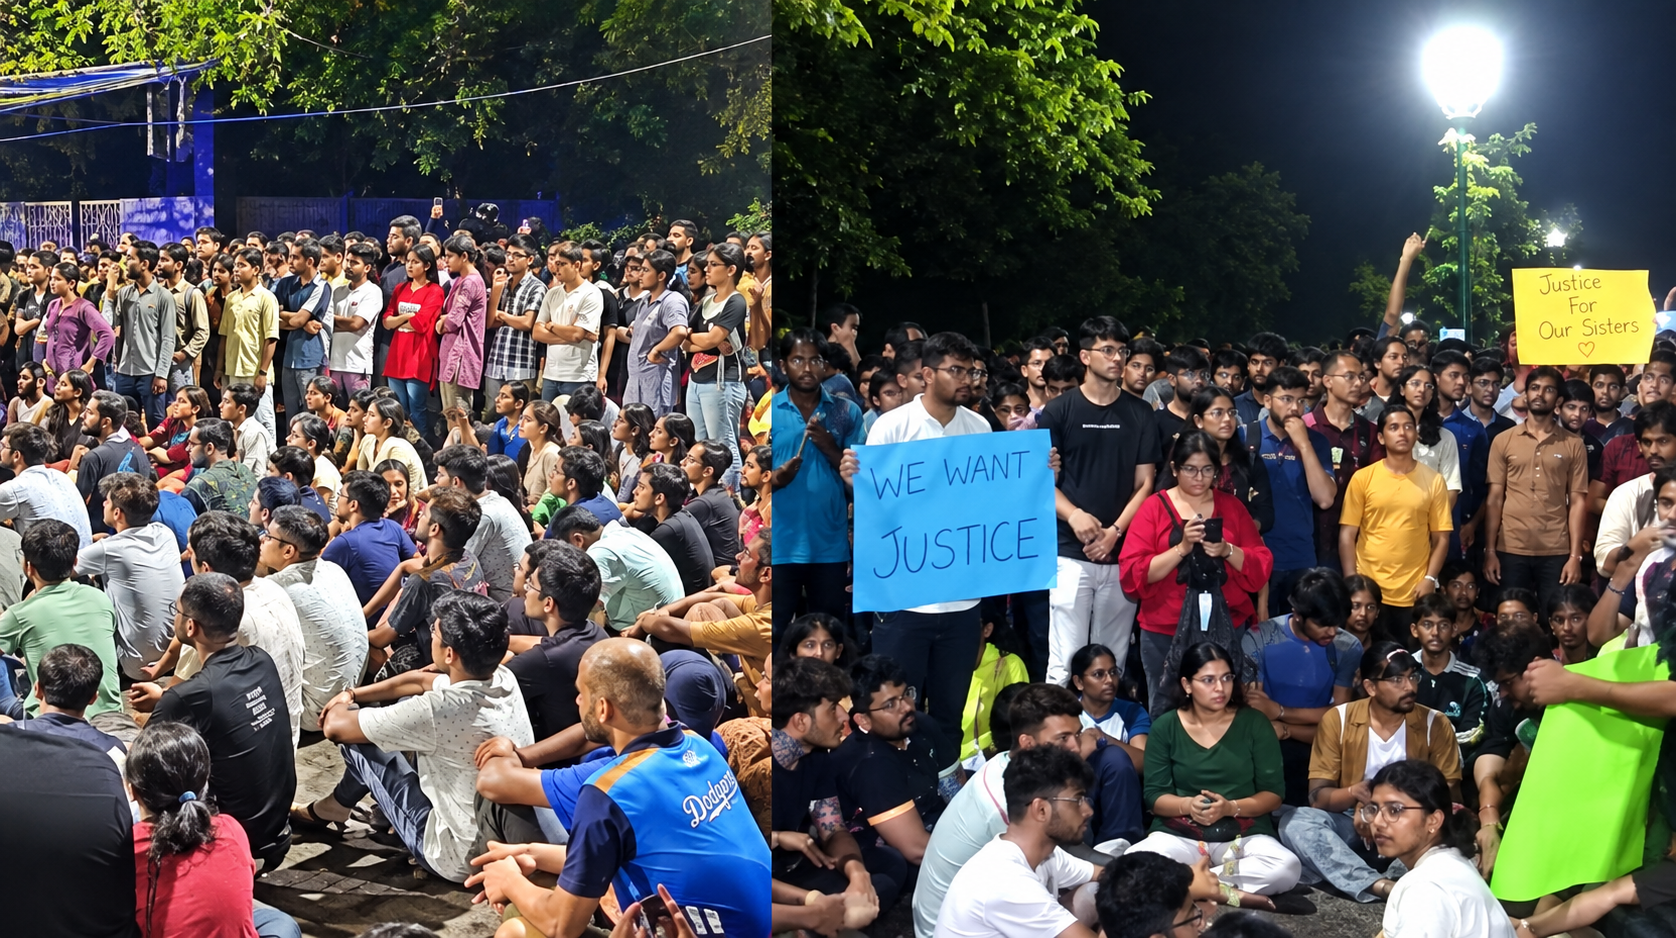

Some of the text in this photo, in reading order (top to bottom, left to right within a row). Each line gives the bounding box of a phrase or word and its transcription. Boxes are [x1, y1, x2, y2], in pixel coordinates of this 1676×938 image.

[1539, 273, 1602, 295] Justice
[1568, 295, 1598, 315] For
[1538, 317, 1640, 340] Our Sisters
[869, 450, 1031, 500] WE WANT
[872, 517, 1039, 580] JUSTICE
